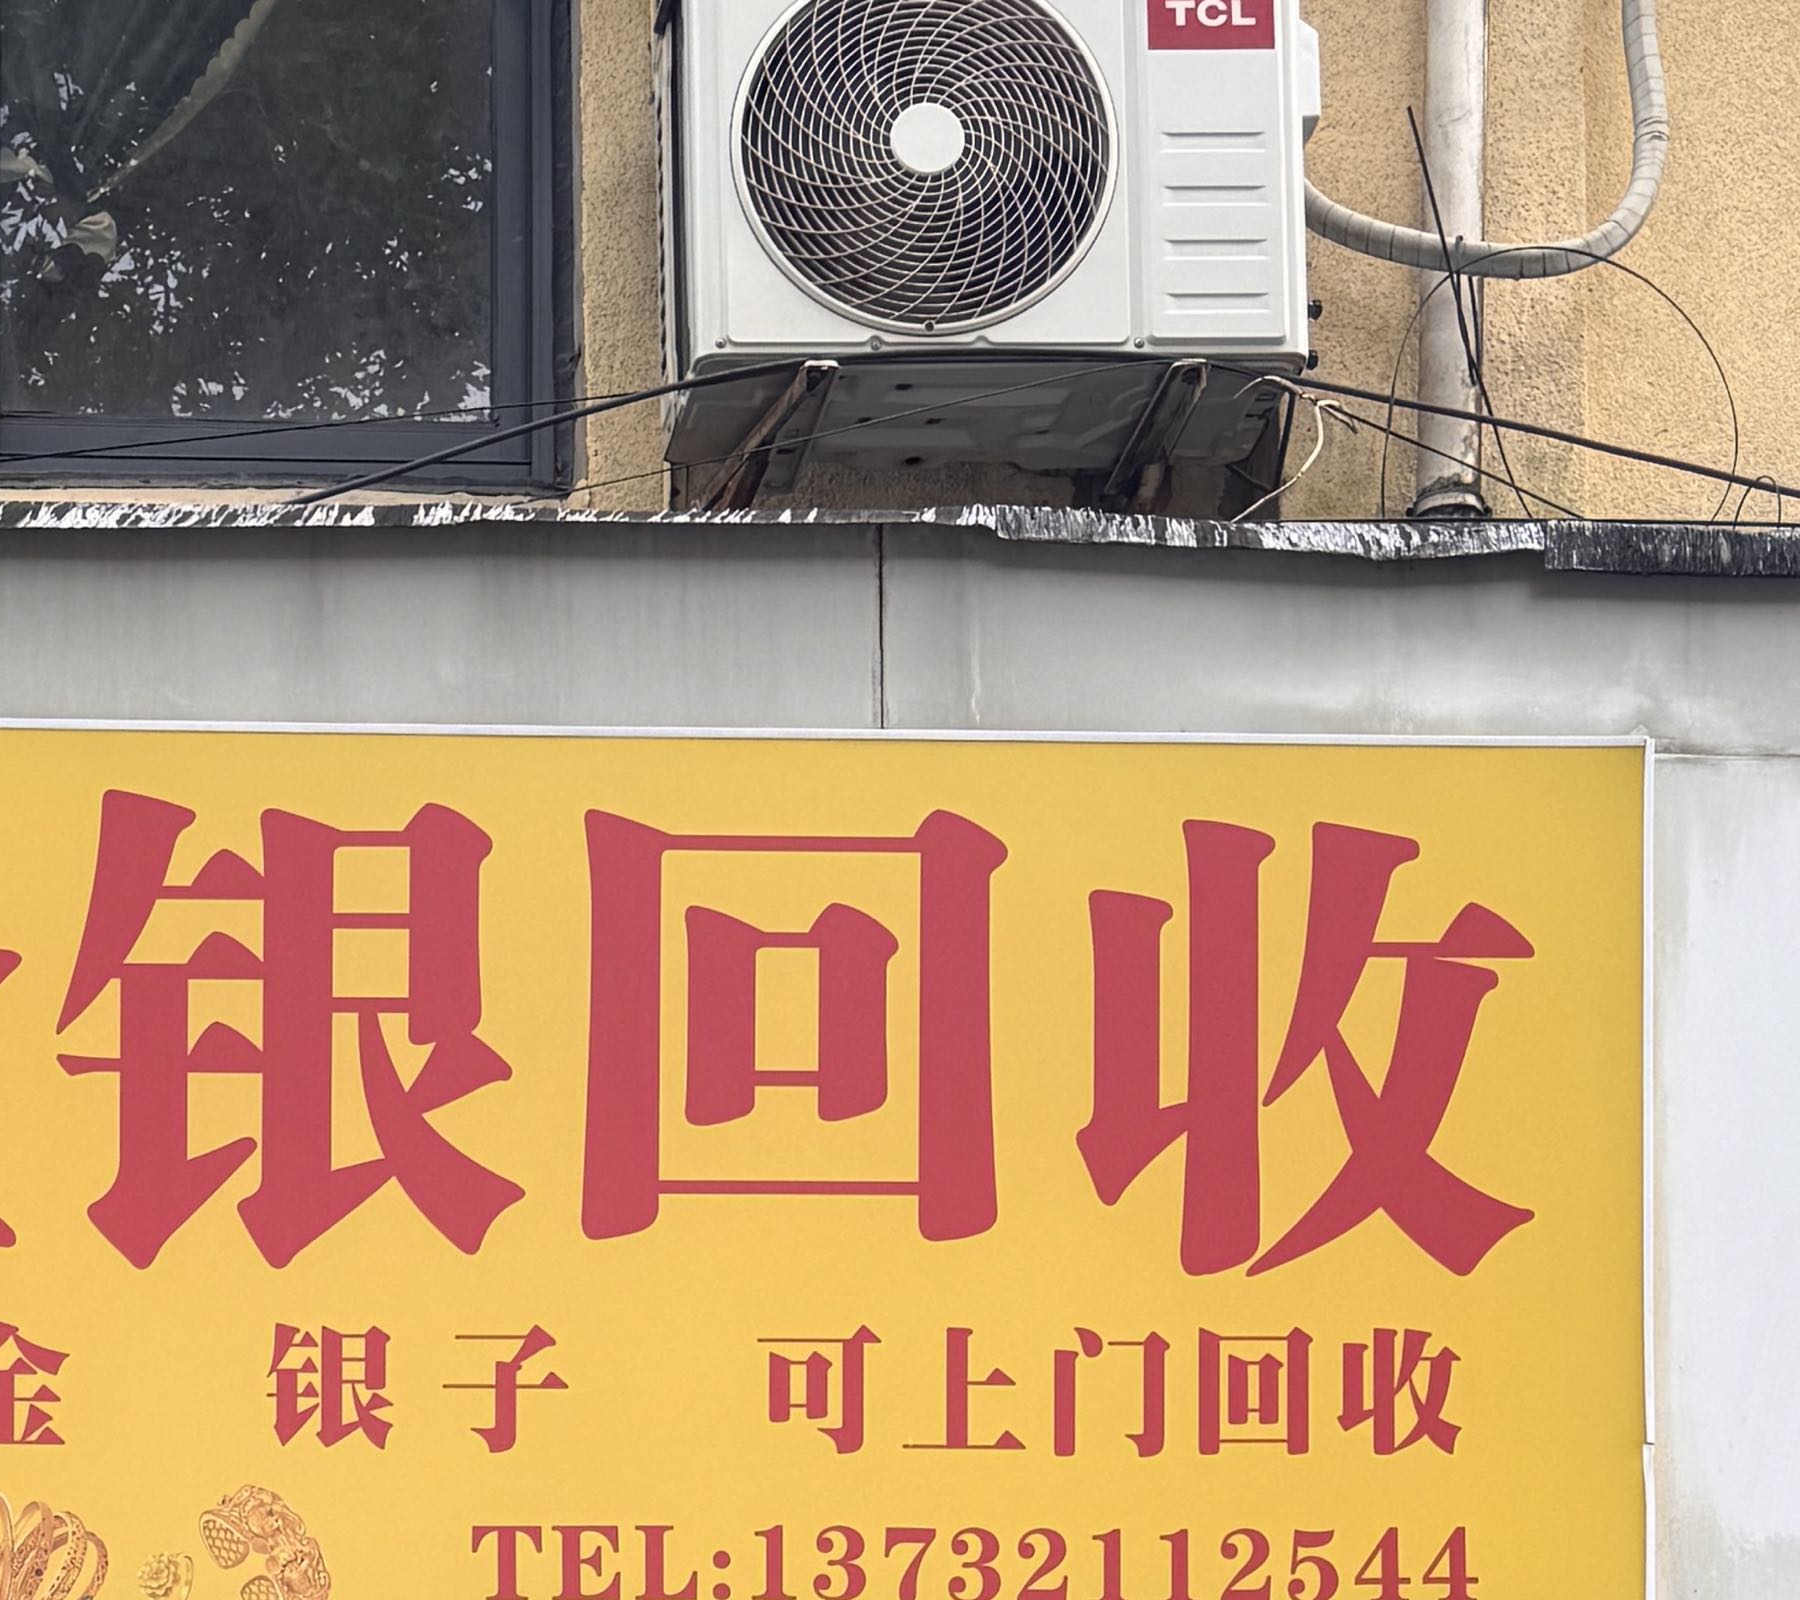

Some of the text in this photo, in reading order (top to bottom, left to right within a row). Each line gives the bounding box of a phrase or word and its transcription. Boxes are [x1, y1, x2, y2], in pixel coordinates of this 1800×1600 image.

[1165, 0, 1257, 27] TCL
[266, 1323, 569, 1453] 银子
[757, 1324, 1462, 1458] 可上门回收
